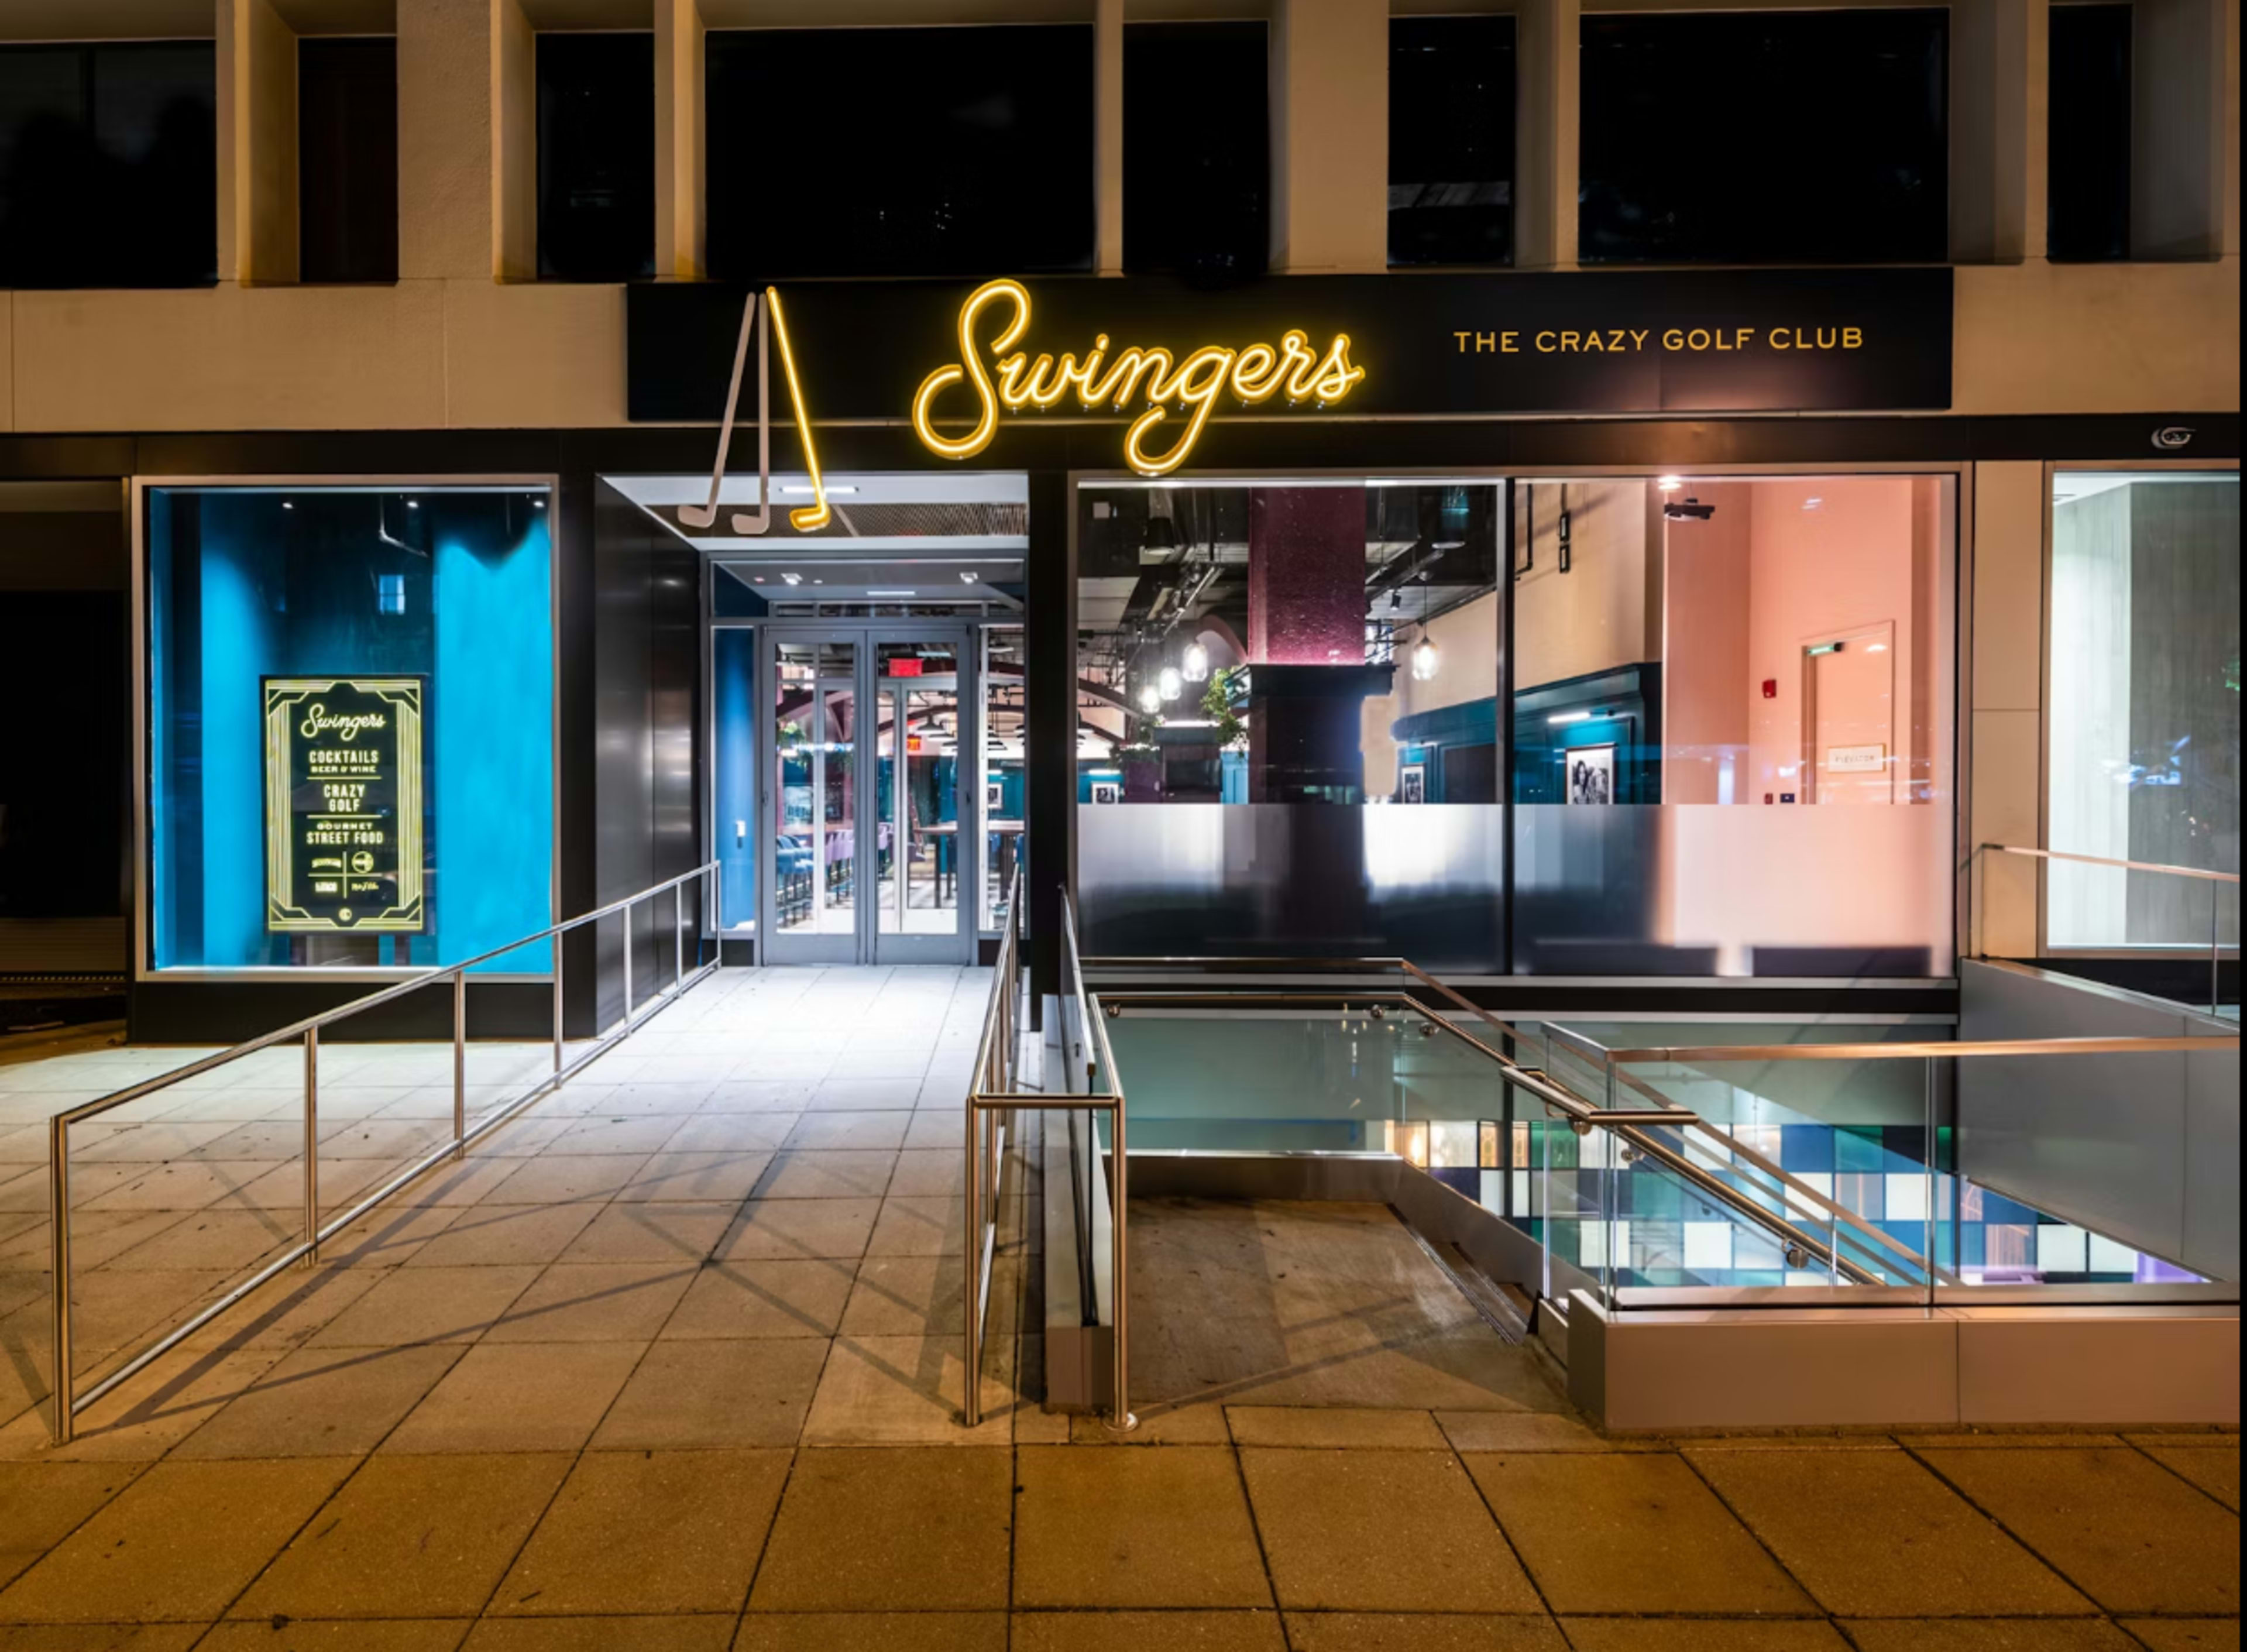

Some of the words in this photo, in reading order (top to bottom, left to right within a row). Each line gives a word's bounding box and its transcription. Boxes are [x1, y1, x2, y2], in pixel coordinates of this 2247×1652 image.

[1454, 331, 1520, 352] THE
[1535, 329, 1649, 352] CRAZY
[1662, 328, 1755, 351] GOLF
[1769, 327, 1863, 349] CLUB
[912, 278, 1366, 475] Swingers
[301, 703, 386, 741] Swingers
[309, 750, 379, 764] COCKTAILS
[311, 765, 338, 773] BEER
[349, 765, 376, 773] WINE
[324, 784, 365, 798] CRAZY
[328, 798, 360, 812] GOLF
[317, 822, 373, 830] GOURMET
[306, 831, 349, 844] STREET
[353, 831, 384, 844] FOOD
